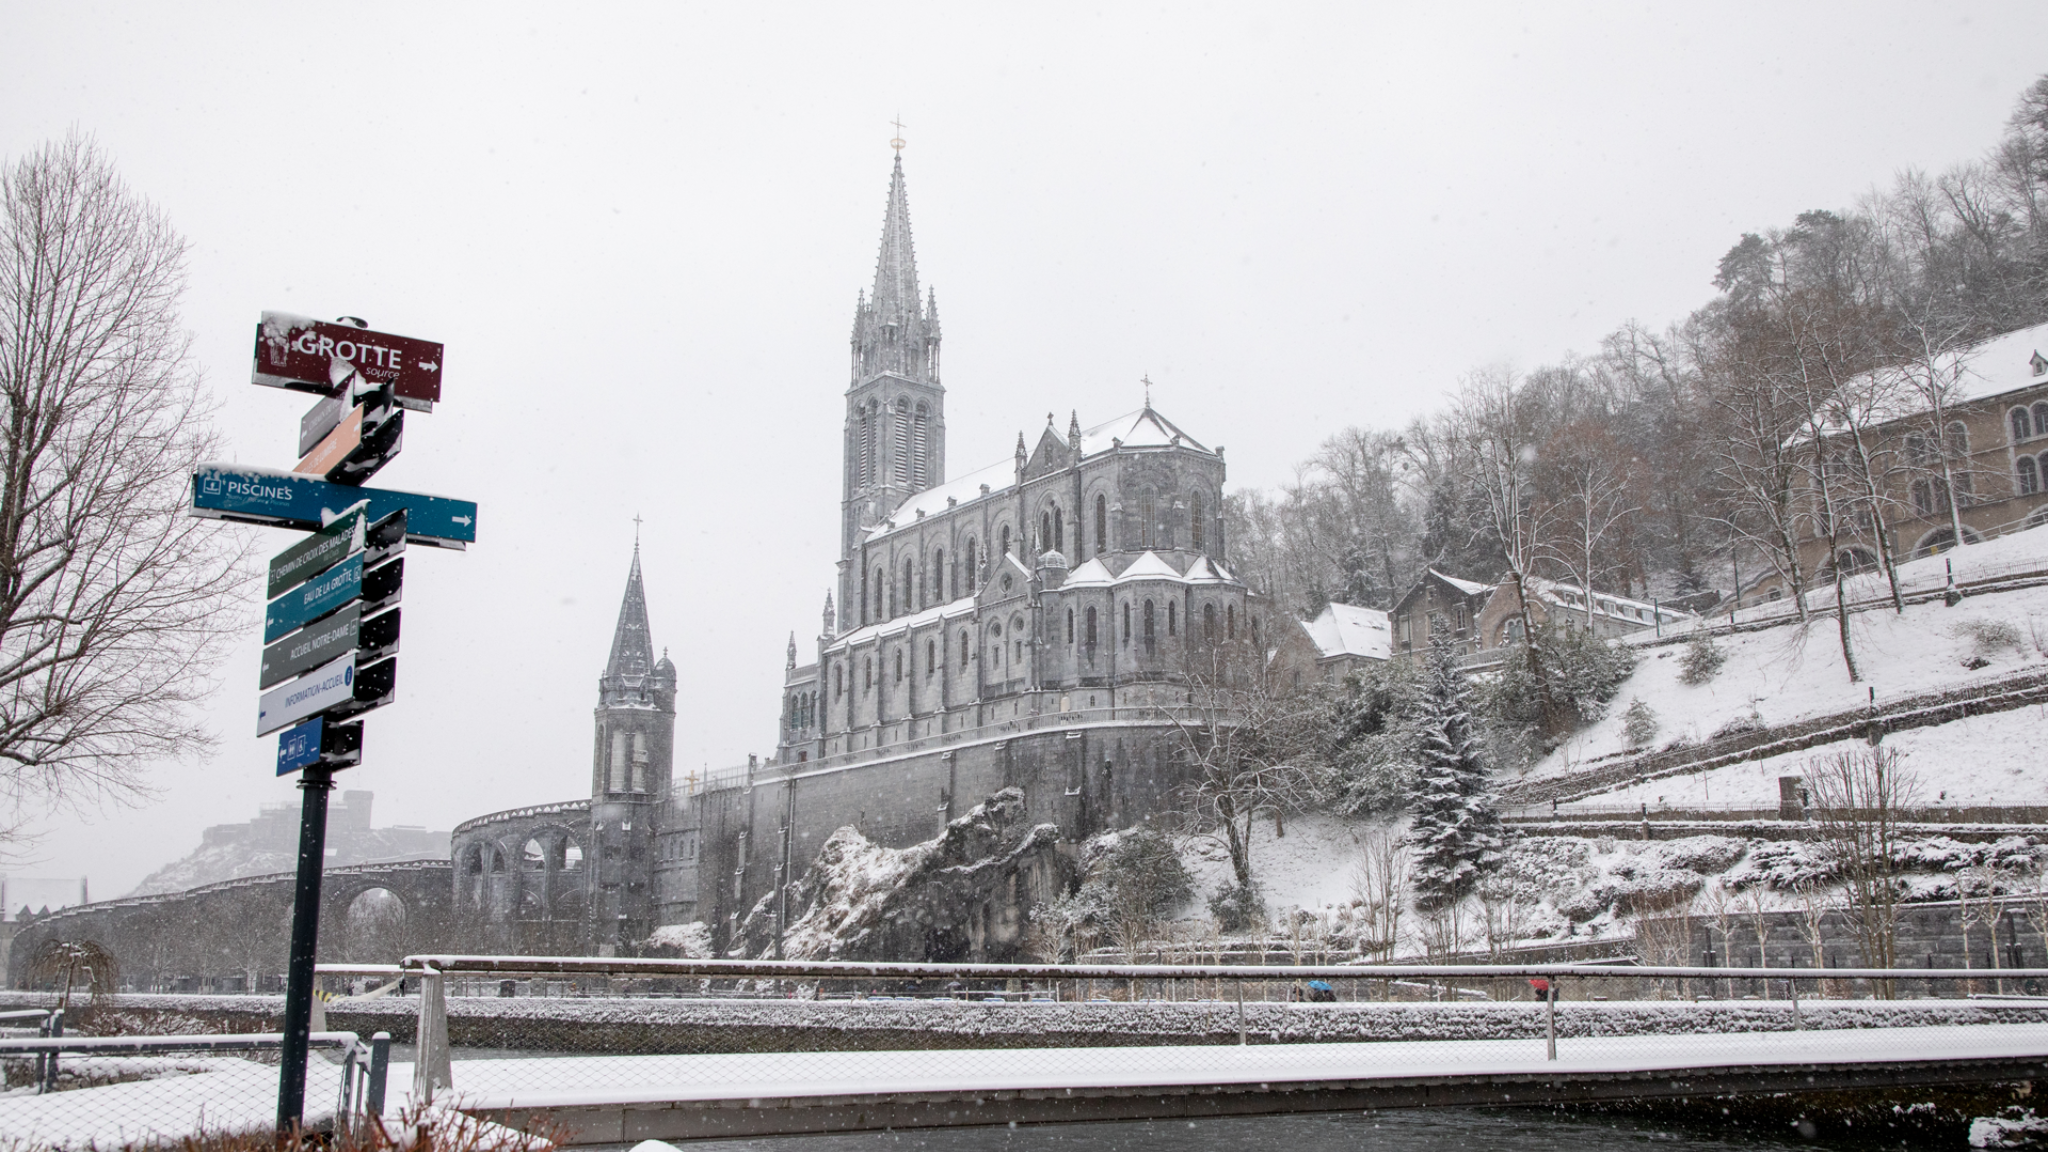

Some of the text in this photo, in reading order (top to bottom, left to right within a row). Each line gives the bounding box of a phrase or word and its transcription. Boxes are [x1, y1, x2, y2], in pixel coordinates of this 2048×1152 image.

[298, 334, 402, 370] GROTTE
[365, 366, 400, 380] source
[228, 481, 293, 500] PISCINES
[276, 561, 296, 579] CHEMIN
[296, 556, 303, 569] DE
[303, 547, 319, 564] CROIX
[319, 540, 329, 556] DES
[329, 526, 355, 549] MALADES
[304, 589, 315, 605] EAU
[315, 585, 323, 599] DE
[322, 581, 330, 595] LA
[331, 569, 352, 590] GROTTE
[290, 624, 349, 660] ACCUEIL NOTRE-DAME
[285, 673, 344, 708] INFORMATION-ACCUEIL
